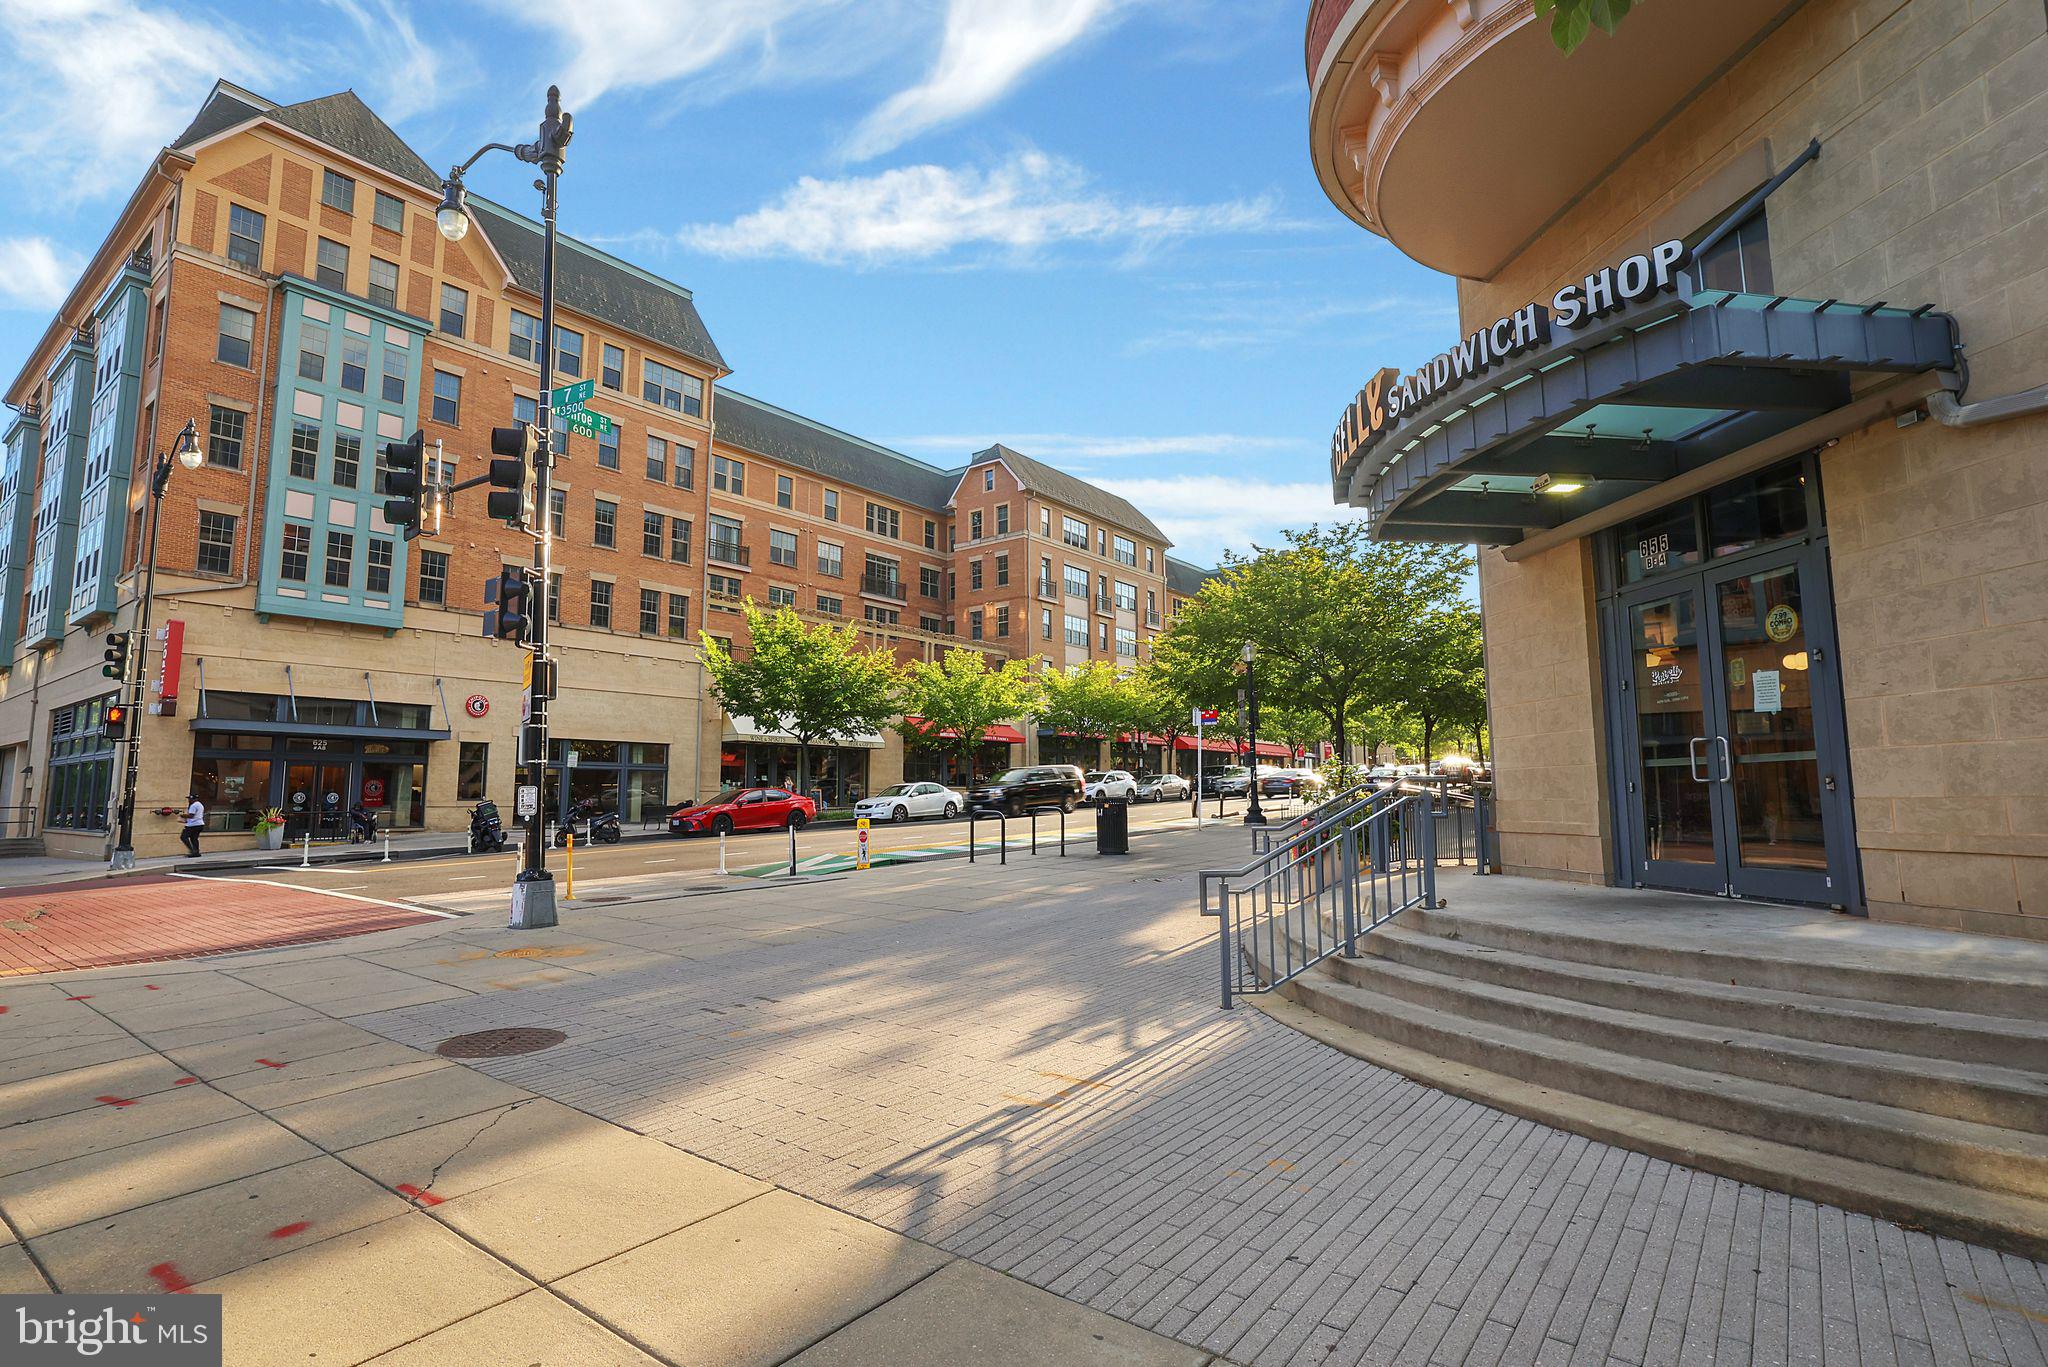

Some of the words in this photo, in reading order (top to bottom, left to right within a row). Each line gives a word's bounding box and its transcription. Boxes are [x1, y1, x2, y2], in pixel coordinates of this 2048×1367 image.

[1332, 367, 1388, 477] BELLY
[1388, 303, 1540, 418] SANDWICH
[1552, 238, 1688, 328] SHOP
[564, 388, 572, 402] 7
[560, 401, 584, 416] 3500
[572, 424, 593, 438] 600
[599, 424, 608, 432] NE
[1640, 534, 1669, 558] 655
[1769, 617, 1793, 628] COMBO
[468, 695, 489, 705] CHIPOTLE
[313, 739, 328, 747] 625
